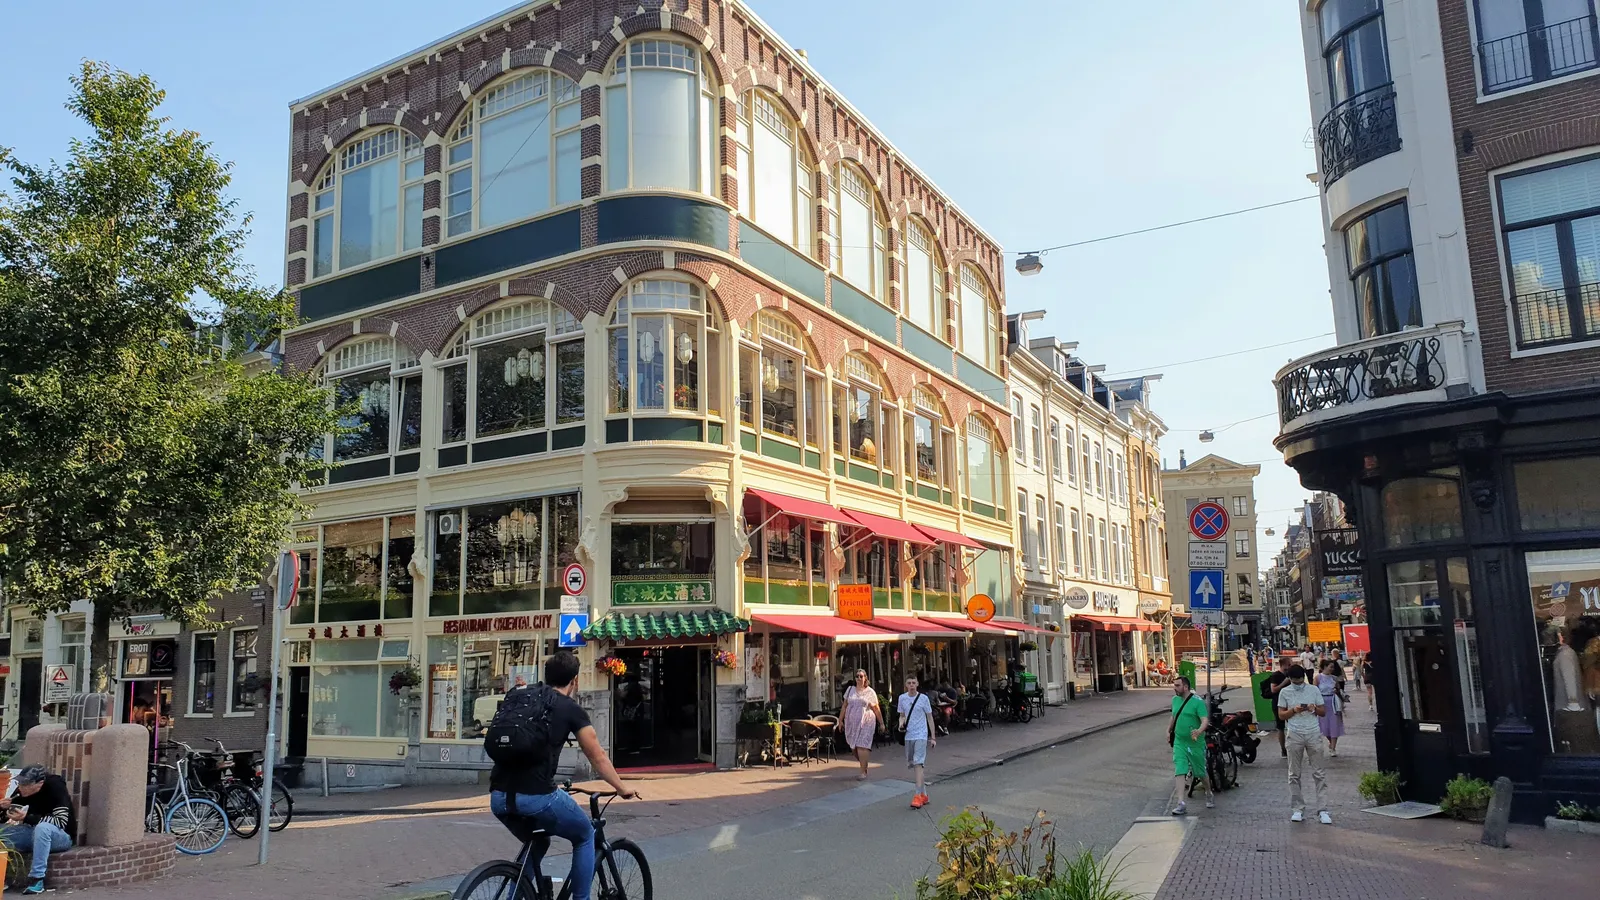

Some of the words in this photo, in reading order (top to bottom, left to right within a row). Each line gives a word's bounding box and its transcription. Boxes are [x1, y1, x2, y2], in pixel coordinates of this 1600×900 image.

[443, 618, 493, 634] RESTAURANT
[493, 615, 532, 631] ORIENTAL
[533, 614, 553, 629] CITY
